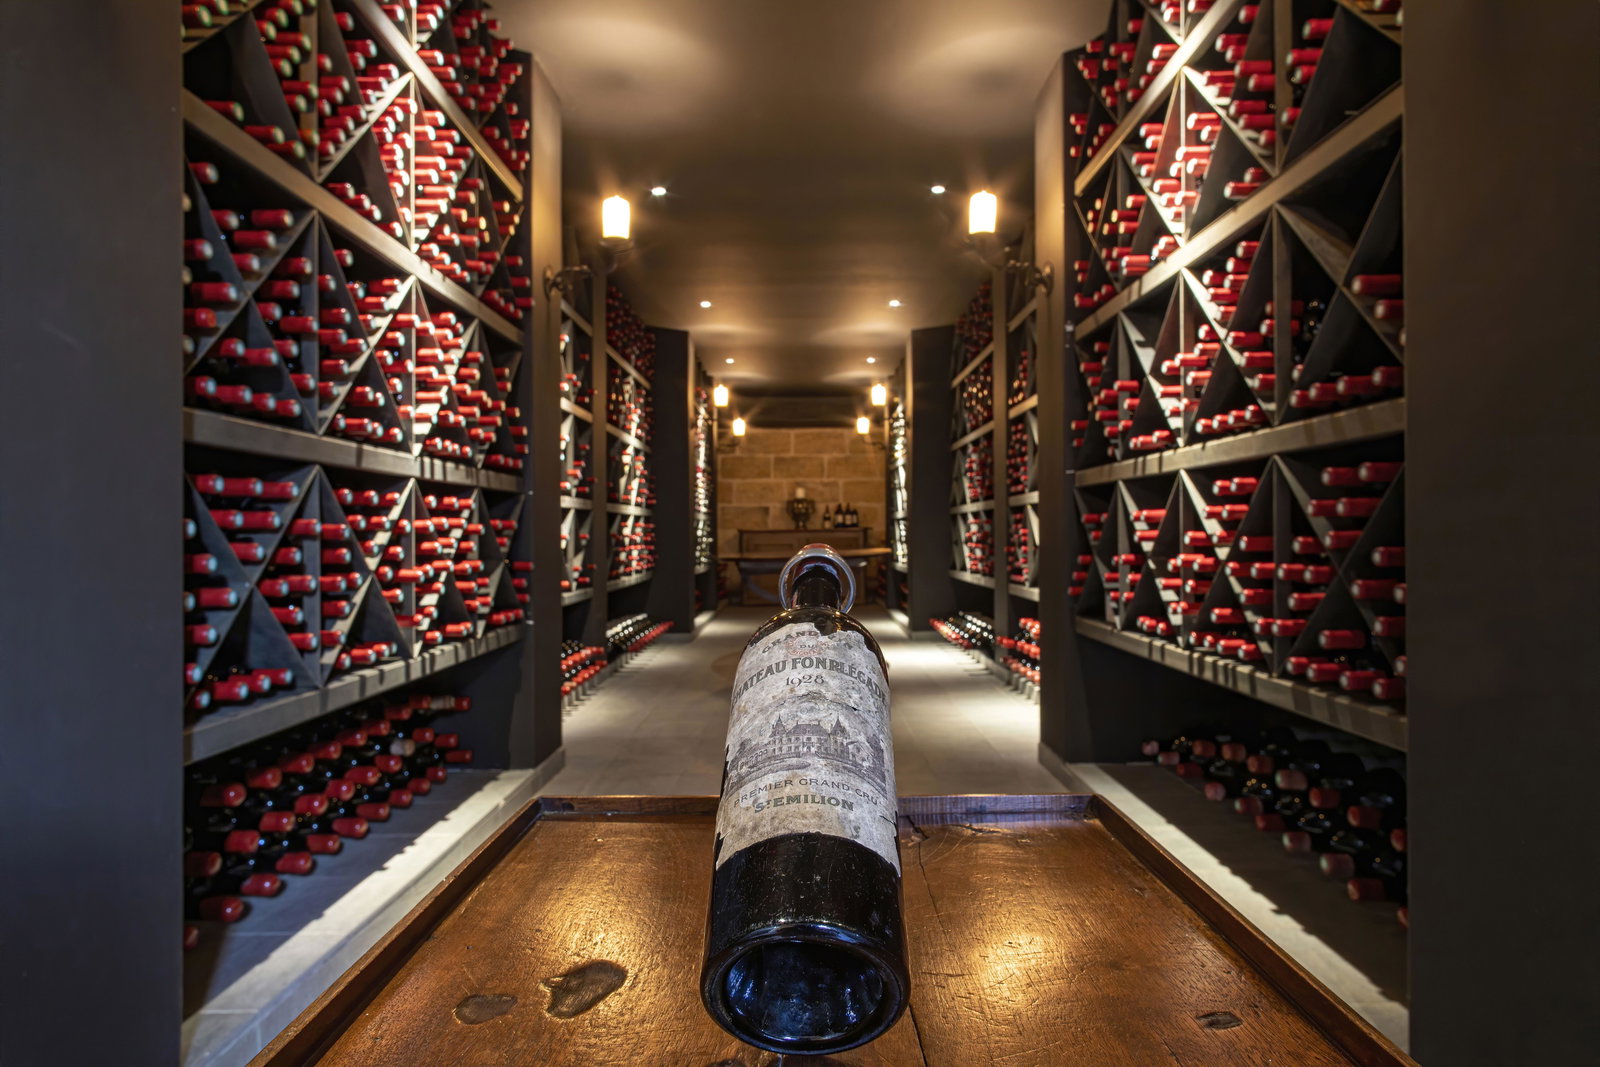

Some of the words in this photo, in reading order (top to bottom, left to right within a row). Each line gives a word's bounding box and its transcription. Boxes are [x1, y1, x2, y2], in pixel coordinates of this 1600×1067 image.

[761, 630, 819, 654] GRAND
[785, 674, 825, 687] 1928
[733, 778, 793, 808] PREMIER
[798, 778, 850, 792] GRAND
[854, 788, 878, 806] CRU
[772, 794, 854, 811] EMILION
